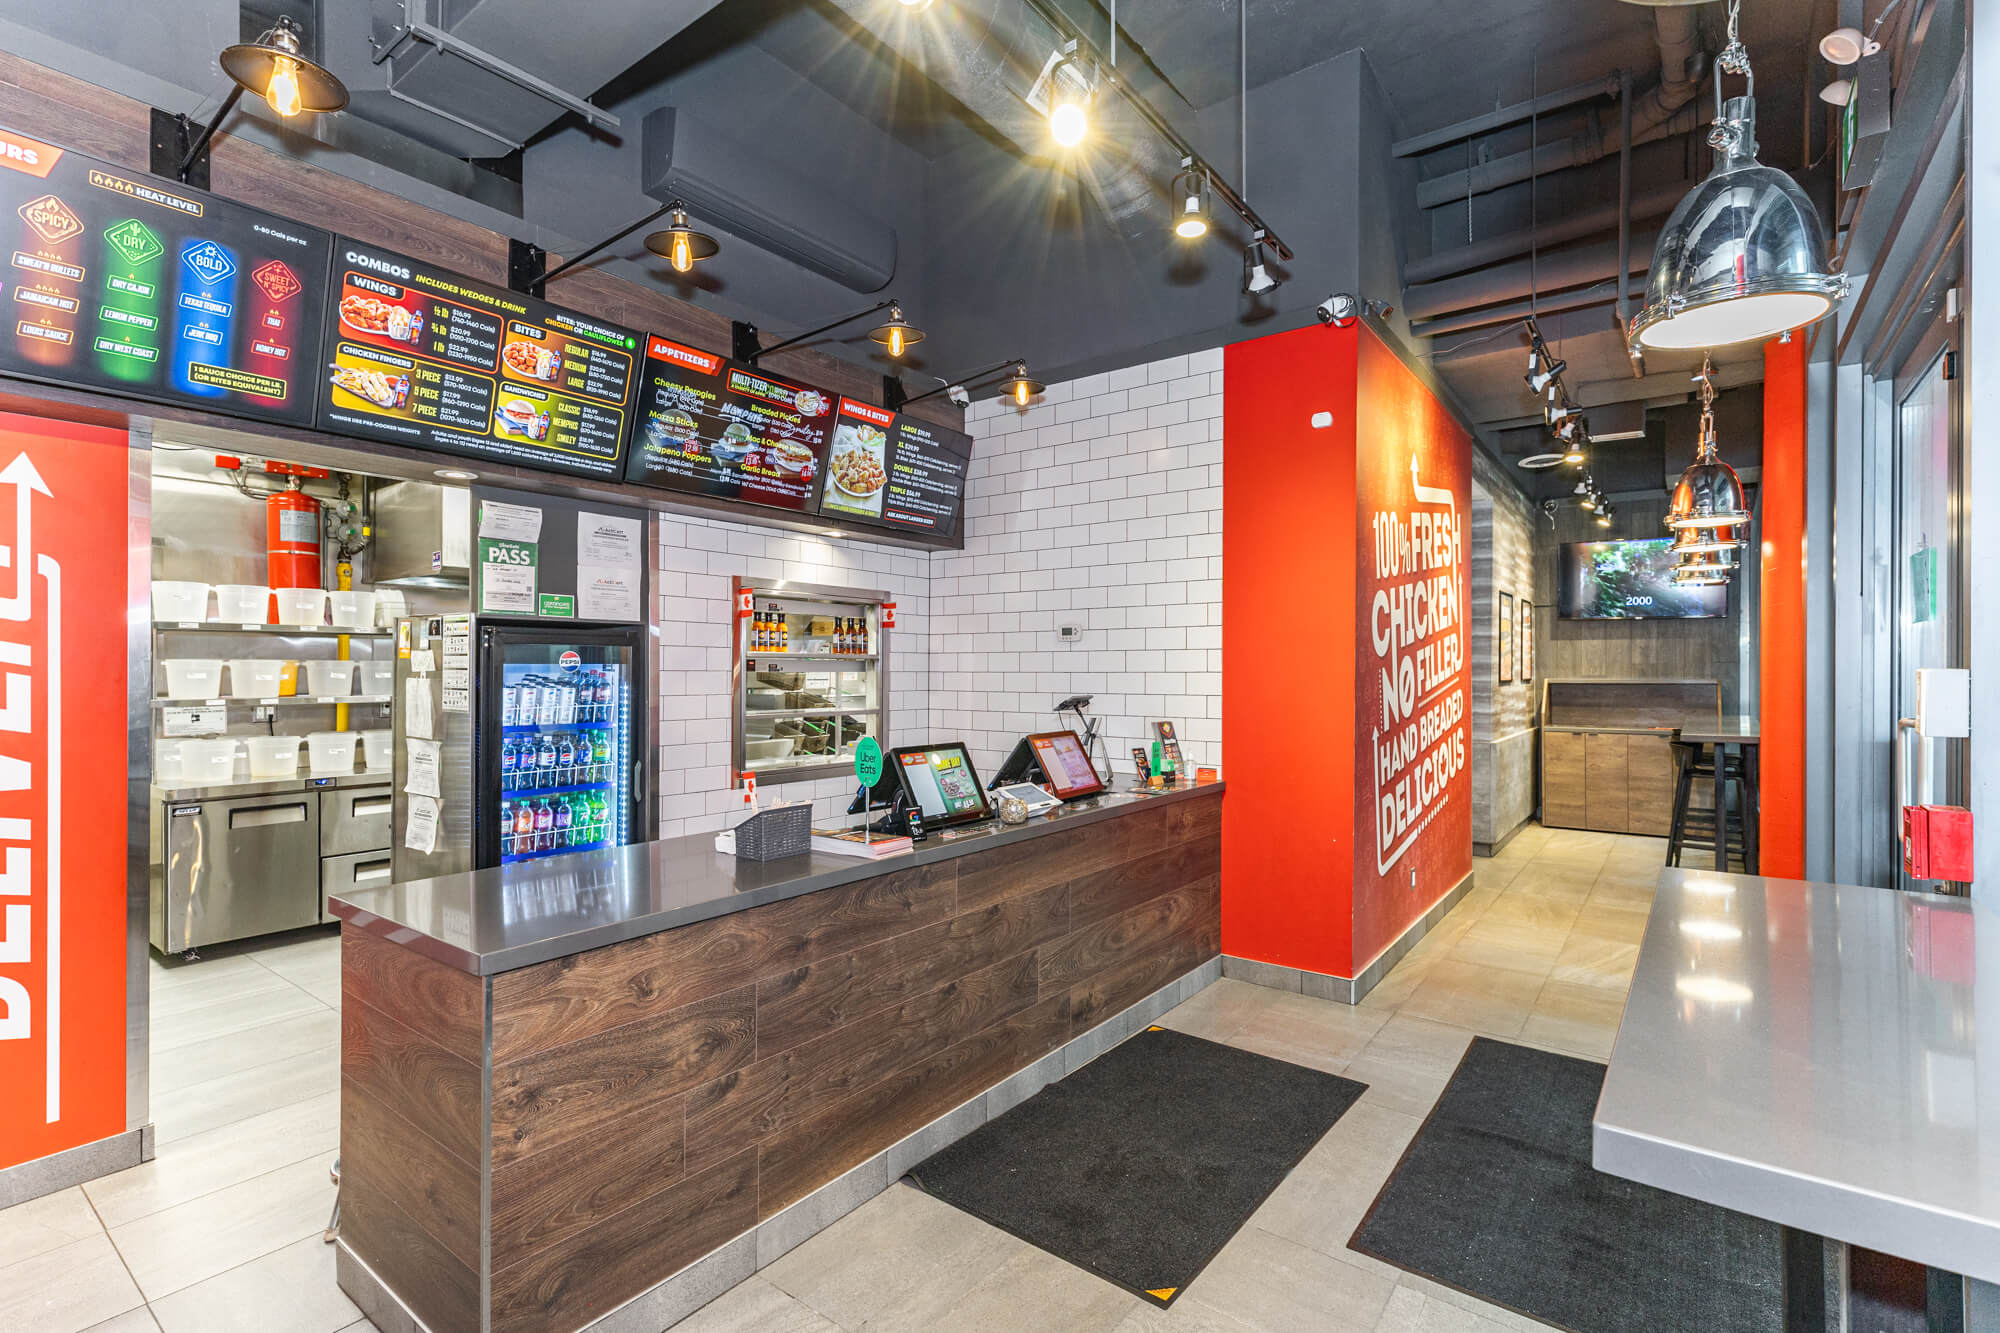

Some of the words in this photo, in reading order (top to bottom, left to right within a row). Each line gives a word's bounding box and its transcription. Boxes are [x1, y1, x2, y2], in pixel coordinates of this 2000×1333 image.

[136, 187, 165, 203] HEAT
[166, 195, 200, 214] LEVEL
[33, 209, 70, 230] SPICY
[123, 234, 146, 250] DRY
[270, 230, 286, 240] Cals
[196, 254, 223, 272] BOLD
[346, 251, 410, 280] COMBOS
[112, 279, 127, 289] DRY
[127, 282, 150, 295] CAJUN
[264, 272, 290, 287] SWEET
[353, 275, 398, 297] WINGS
[271, 284, 289, 294] SPICY
[415, 274, 459, 294] INCLUDES
[459, 287, 494, 304] WEDGES
[495, 299, 501, 307] &
[501, 300, 527, 315] DRINK
[19, 290, 60, 307] JAMAICAN
[59, 299, 75, 310] HOT
[184, 296, 204, 308] TEXAS
[203, 300, 228, 314] TEQUILA
[103, 309, 128, 321] LEMON
[127, 315, 153, 327] PEPPER
[266, 316, 282, 327] THAI
[44, 329, 69, 342] SAUCE
[188, 328, 205, 339] JERK
[514, 324, 542, 339] BITES
[544, 317, 573, 332] CHICKEN
[573, 327, 584, 335] OR
[583, 330, 624, 347] CAULIFLOWER
[556, 315, 576, 326] BITES:
[575, 320, 593, 331] YOUR
[593, 326, 617, 339] CHOICE
[616, 333, 625, 341] OF
[99, 340, 115, 350] DRY
[114, 343, 132, 354] WEST
[132, 347, 154, 358] COAST
[255, 343, 274, 355] HONEY
[273, 348, 287, 357] HOT
[343, 345, 379, 361] CHICKEN
[379, 354, 412, 368] FINGERS
[564, 343, 590, 359] REGULAR
[654, 344, 710, 368] APPETIZERS
[564, 360, 587, 374] MEDIUM
[198, 366, 225, 378] SAUCE
[225, 371, 256, 384] CHOICE
[256, 377, 270, 386] PER
[422, 371, 442, 384] PIECE
[567, 376, 585, 389] LARGE
[732, 372, 768, 391] MULTI-TIZER
[210, 375, 232, 386] BITES
[232, 378, 281, 396] EQUIVALENT)
[414, 386, 420, 396] 5
[420, 387, 440, 401] PIECE
[503, 384, 546, 401] SANDWICHES
[654, 377, 683, 391] Cheesy
[684, 386, 716, 400] Perogies
[412, 403, 418, 413] 7
[417, 404, 438, 417] PIECE
[558, 402, 581, 416] CLASSIC
[751, 404, 779, 418] Breaded
[844, 402, 867, 416] WINGS
[871, 411, 889, 423] BITES
[552, 417, 579, 430] MEMPHIS
[649, 410, 674, 422] Mozza
[675, 416, 699, 428] Sticks
[397, 425, 421, 436] WEIGHTS
[901, 424, 917, 435] LARGE
[556, 433, 577, 445] SMILEY
[682, 450, 712, 464] Poppers
[740, 464, 761, 474] Garlic
[761, 468, 780, 478] Bread
[893, 464, 914, 474] DOUBLE
[890, 486, 906, 495] TRIPLE
[1372, 511, 1411, 580] 100%
[1410, 511, 1462, 573] FRESH
[488, 546, 531, 566] PASS
[1626, 596, 1653, 606] 2000
[1371, 575, 1459, 658] CHICKEN
[1381, 655, 1415, 733] NO
[1416, 633, 1464, 697] FILLER
[1379, 723, 1418, 787] HAND
[1419, 689, 1464, 753] BREADED
[860, 752, 876, 763] Uber
[860, 763, 876, 775] Eats
[1381, 727, 1465, 853] DELICIOUS
